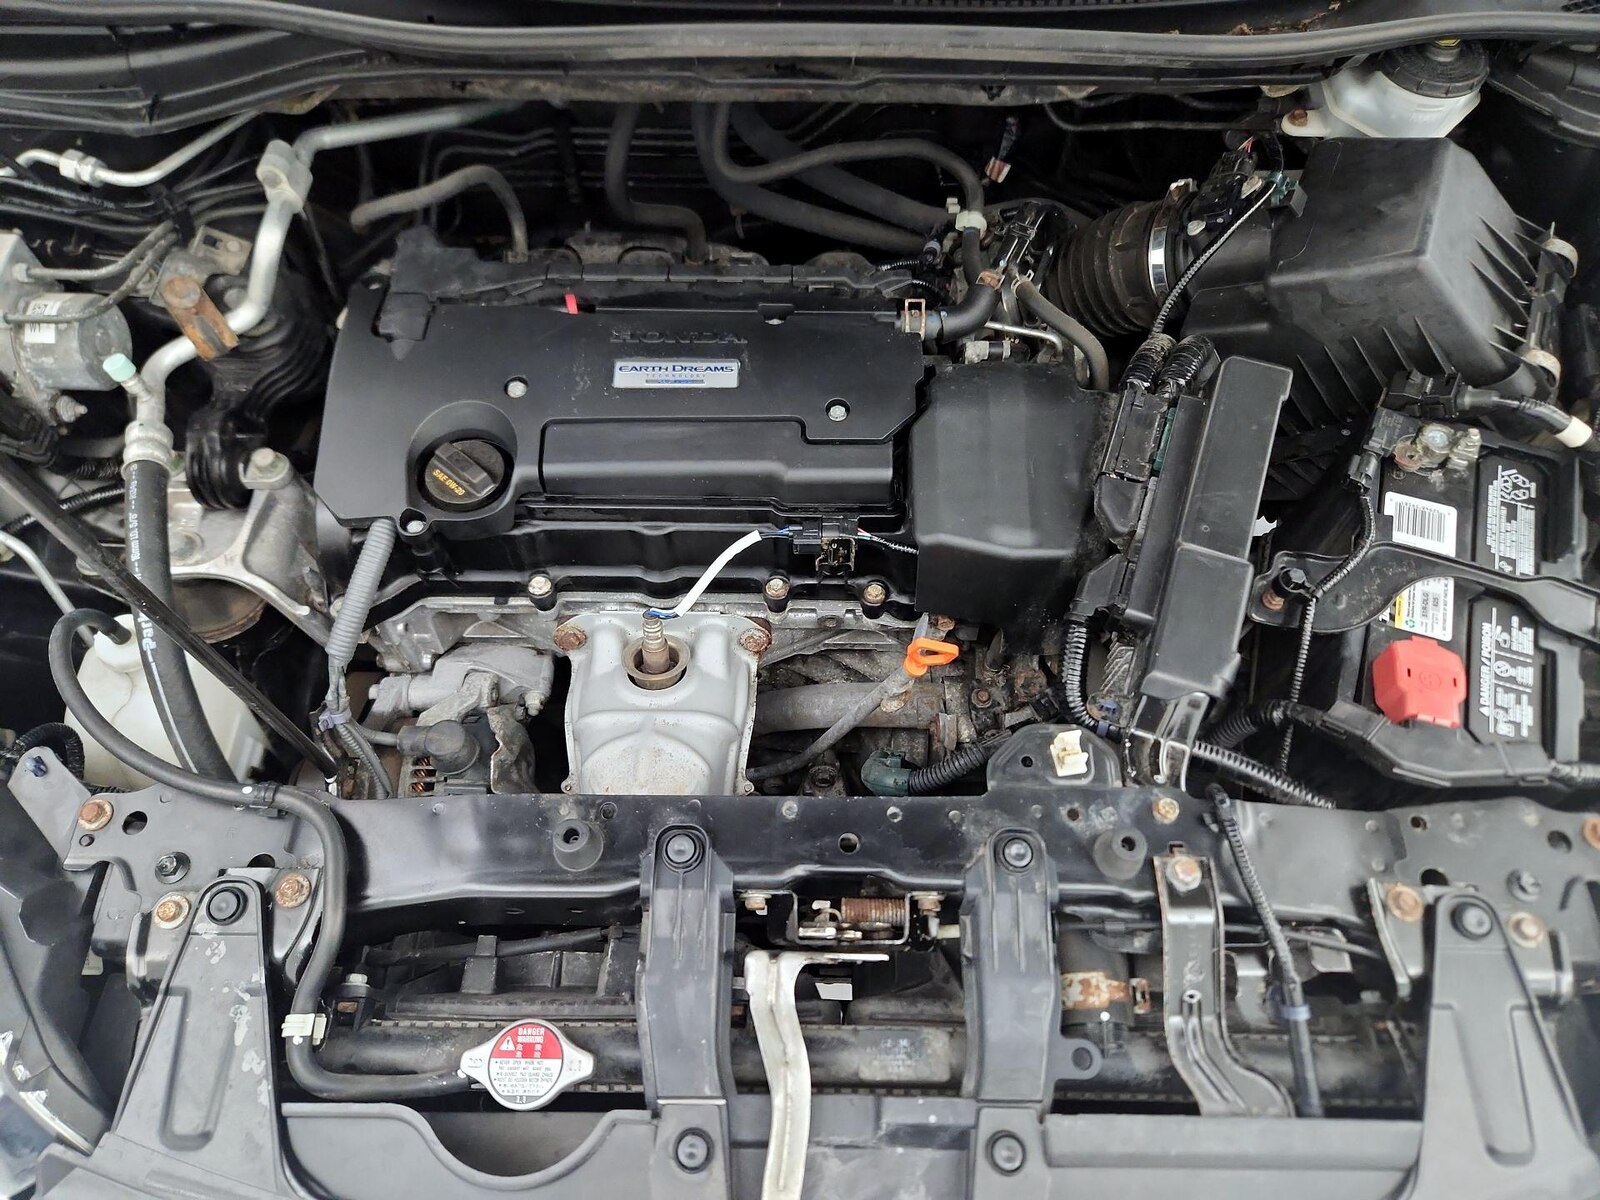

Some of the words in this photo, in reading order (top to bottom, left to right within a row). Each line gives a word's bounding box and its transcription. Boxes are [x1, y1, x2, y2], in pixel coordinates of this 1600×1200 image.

[610, 327, 748, 343] HONDA
[618, 365, 669, 373] EARTH
[672, 364, 734, 373] DREAMS
[433, 469, 448, 483] SAE
[1481, 622, 1492, 657] POISON
[1479, 664, 1491, 706] DANGER
[518, 1027, 545, 1036] DANGER
